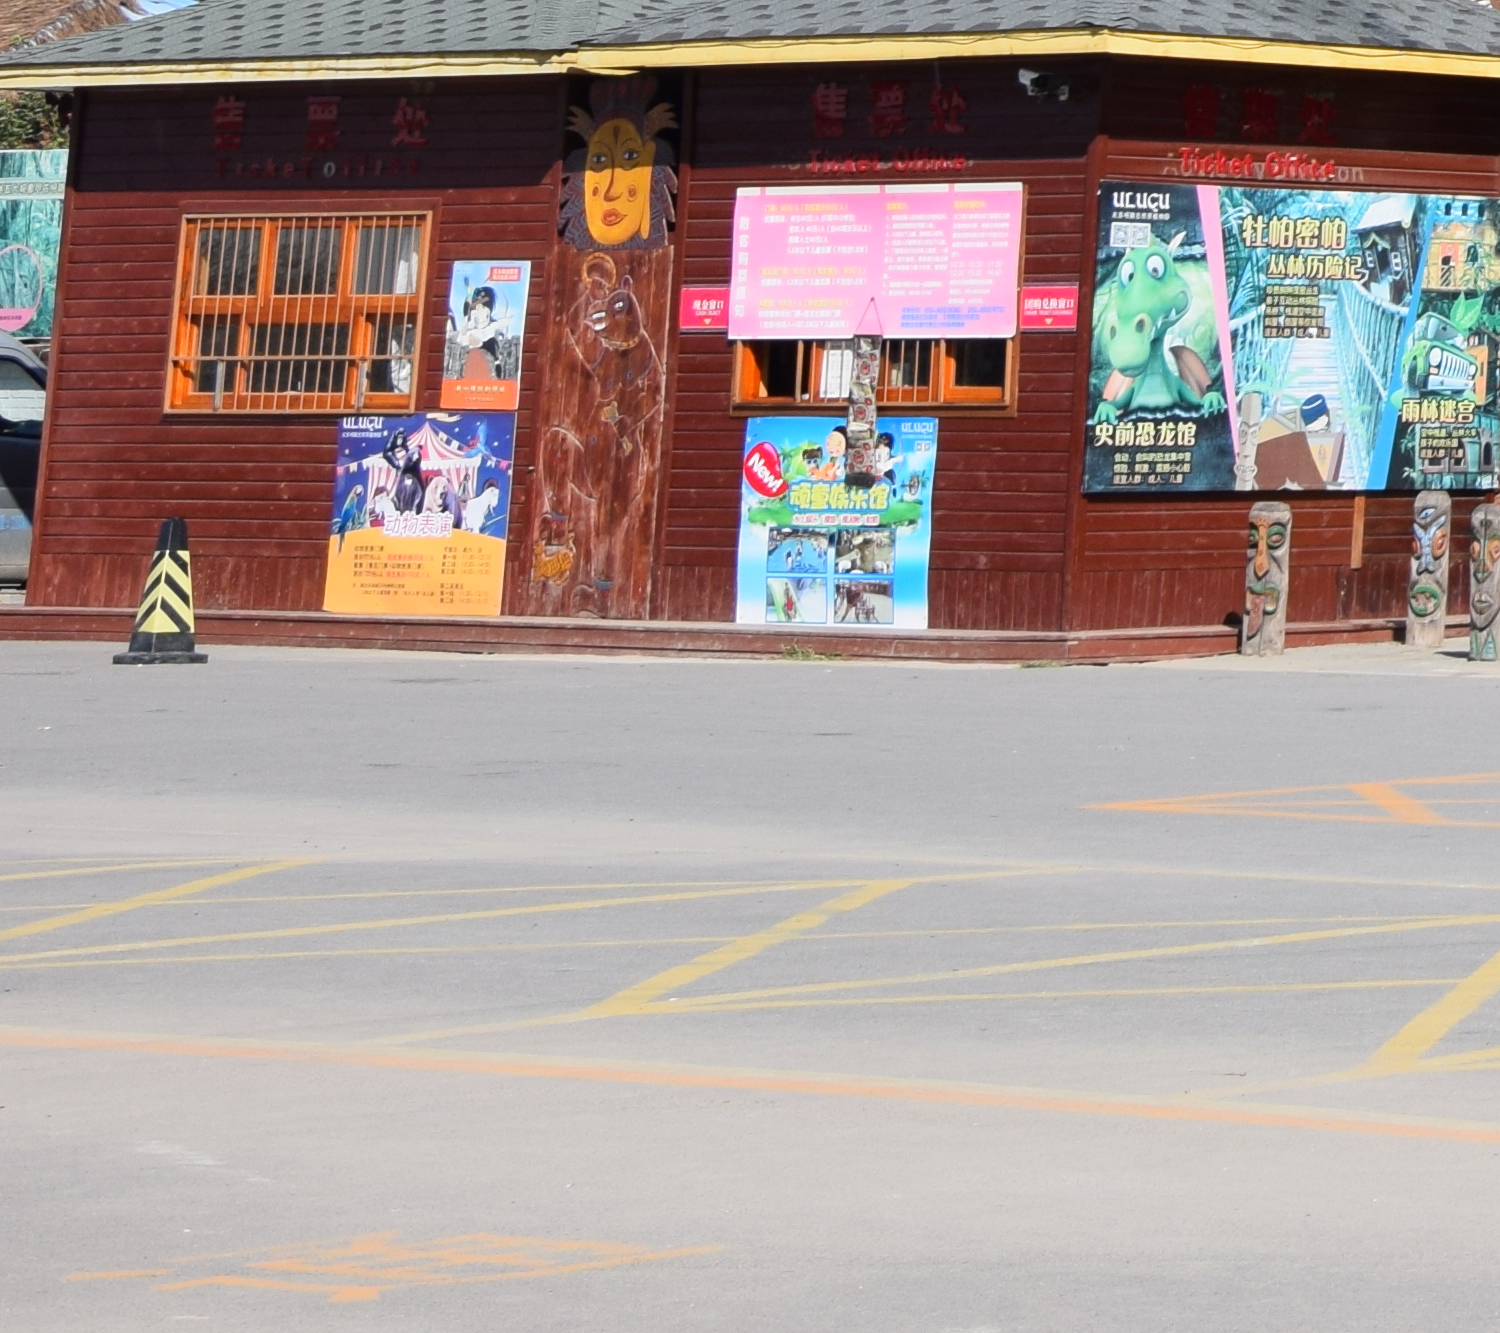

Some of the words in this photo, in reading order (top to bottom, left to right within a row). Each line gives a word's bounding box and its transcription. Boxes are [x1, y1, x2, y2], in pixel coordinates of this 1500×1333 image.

[1179, 147, 1253, 176] Ticket
[1264, 151, 1337, 180] Office
[1266, 253, 1363, 280] 丛林历险记
[1402, 398, 1476, 423] 雨林迷宫
[1094, 421, 1197, 446] 史前恐龙馆
[747, 452, 784, 493] New!
[384, 513, 453, 536] 动物表演
